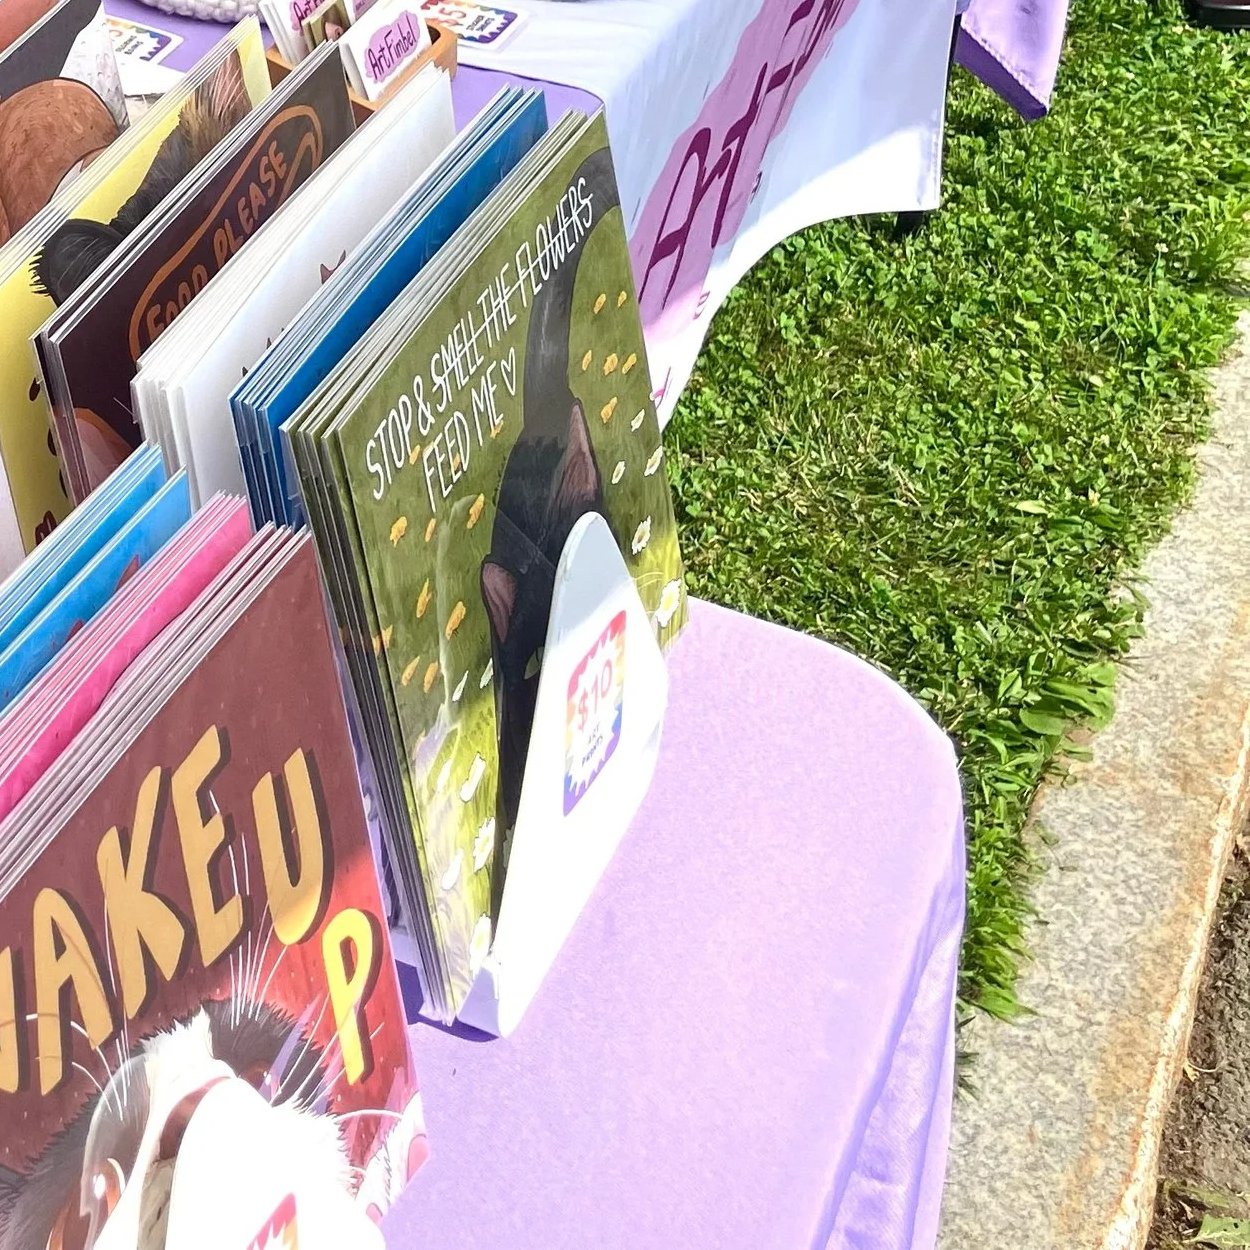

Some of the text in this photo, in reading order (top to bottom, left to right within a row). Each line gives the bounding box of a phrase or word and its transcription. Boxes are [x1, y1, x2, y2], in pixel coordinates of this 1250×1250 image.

[367, 18, 418, 80] ArtFimbel
[213, 140, 287, 267] PLEASE
[366, 176, 593, 500] STOP & SMELL THE FLOWERS
[422, 361, 504, 513] FEED ME
[577, 658, 613, 734] $10
